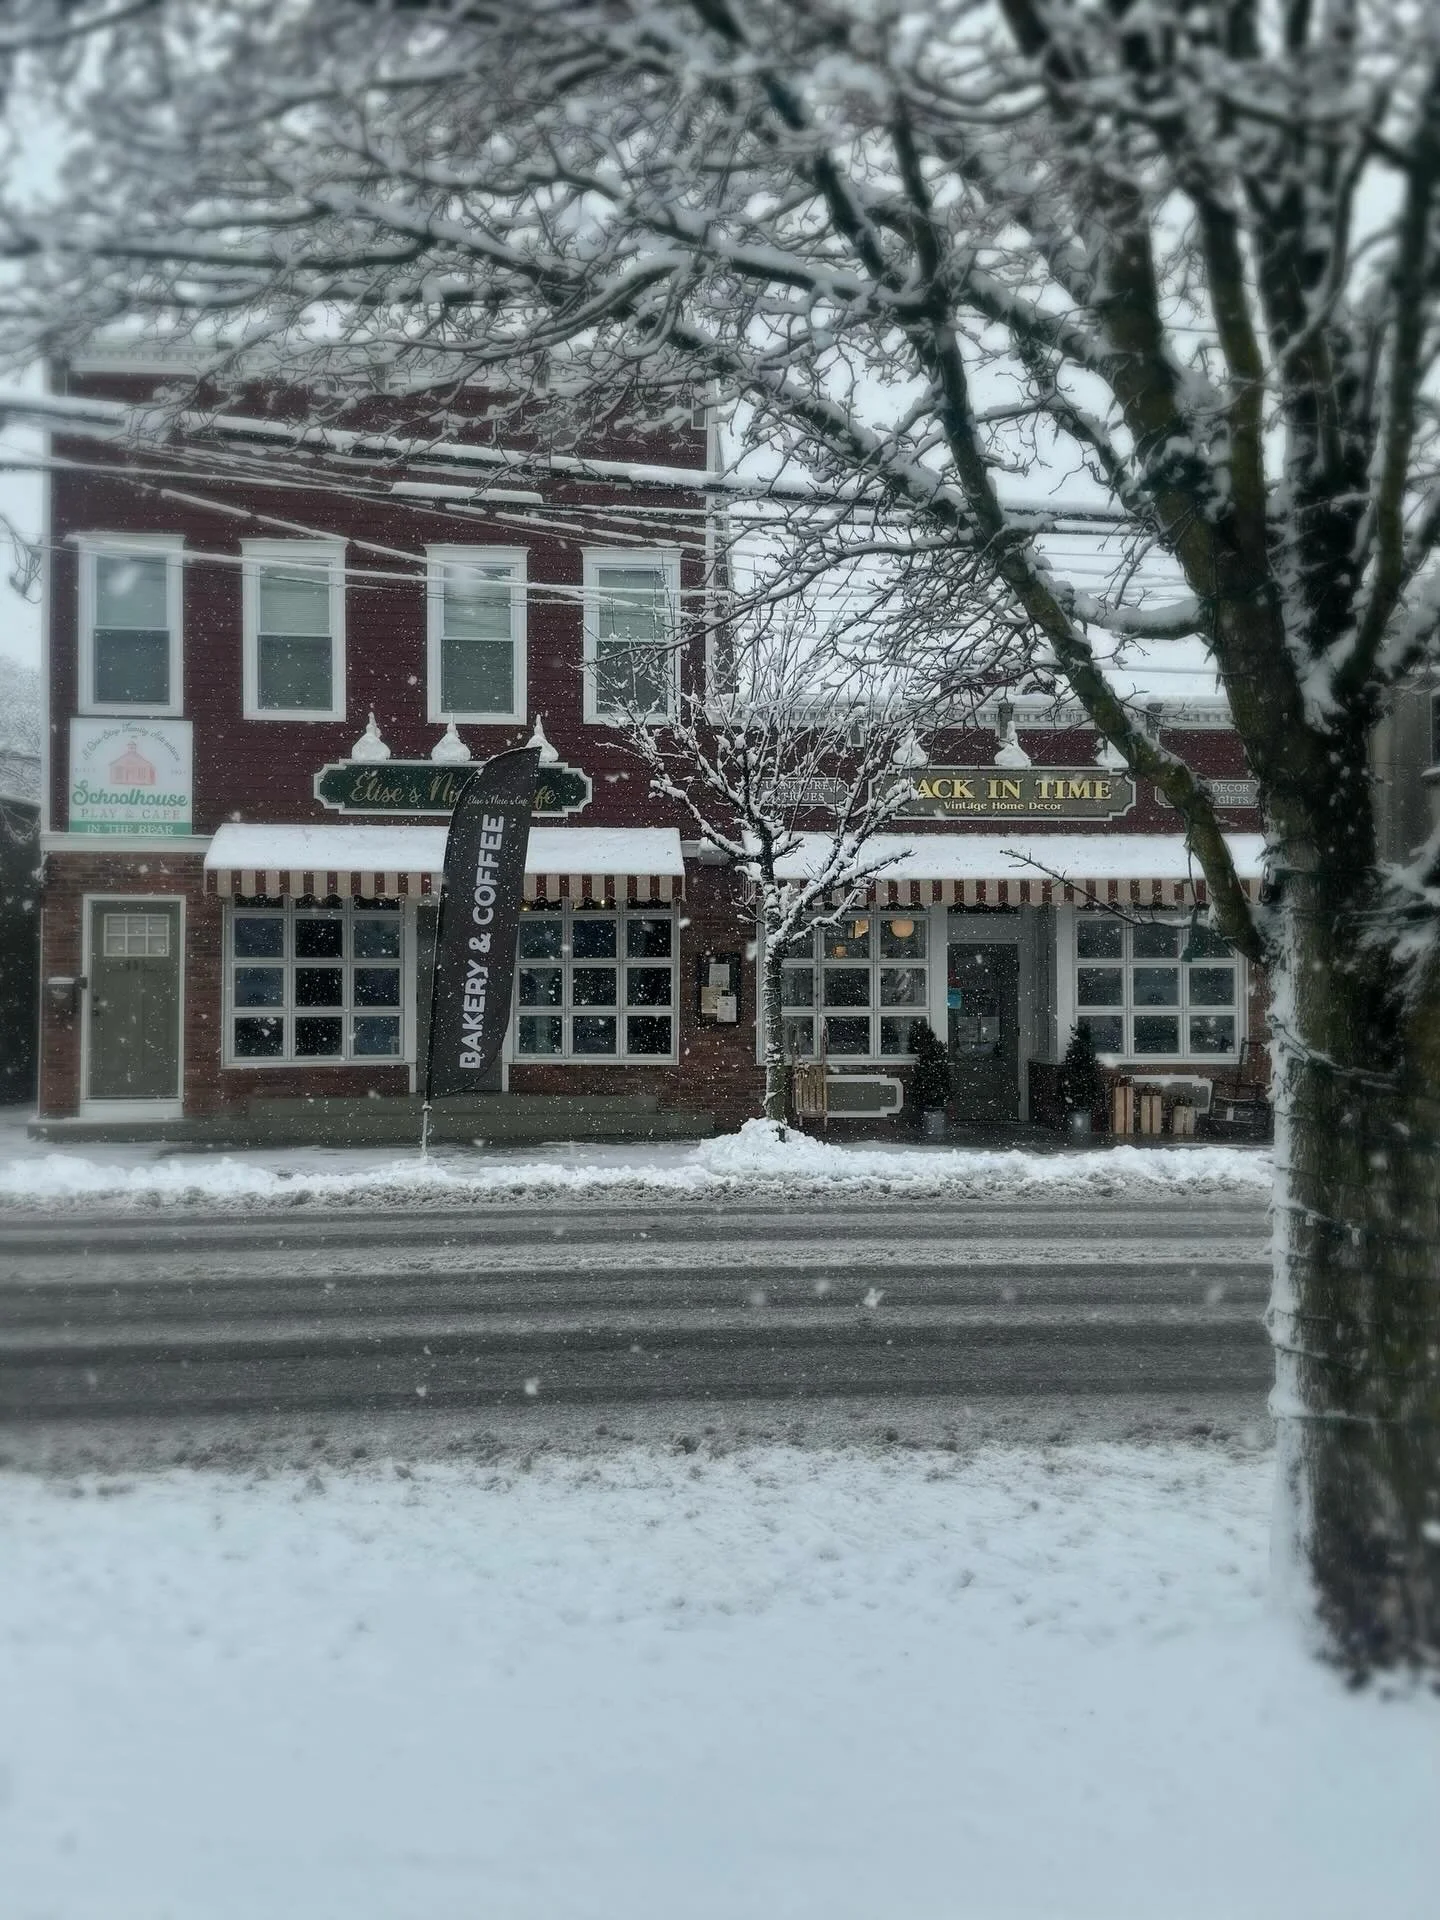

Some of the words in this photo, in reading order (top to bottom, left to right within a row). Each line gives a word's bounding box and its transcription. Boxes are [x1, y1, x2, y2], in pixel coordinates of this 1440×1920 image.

[72, 780, 188, 807] Schoolhouse
[916, 778, 975, 799] ACK
[987, 778, 1024, 799] IN
[1035, 778, 1112, 800] TIME
[1212, 783, 1249, 793] DECOR
[943, 800, 988, 812] Vintage
[992, 801, 1024, 811] Home
[1028, 801, 1063, 811] Decor
[1218, 795, 1249, 804] GIFTS
[80, 807, 117, 818] PLAY
[125, 808, 136, 819] &
[142, 809, 181, 820] CAFE
[87, 823, 100, 833] IN
[108, 824, 133, 834] THE
[139, 824, 175, 835] REAR
[472, 813, 505, 926] COFFEE
[468, 932, 492, 953] &
[459, 959, 490, 1069] BAKERY
